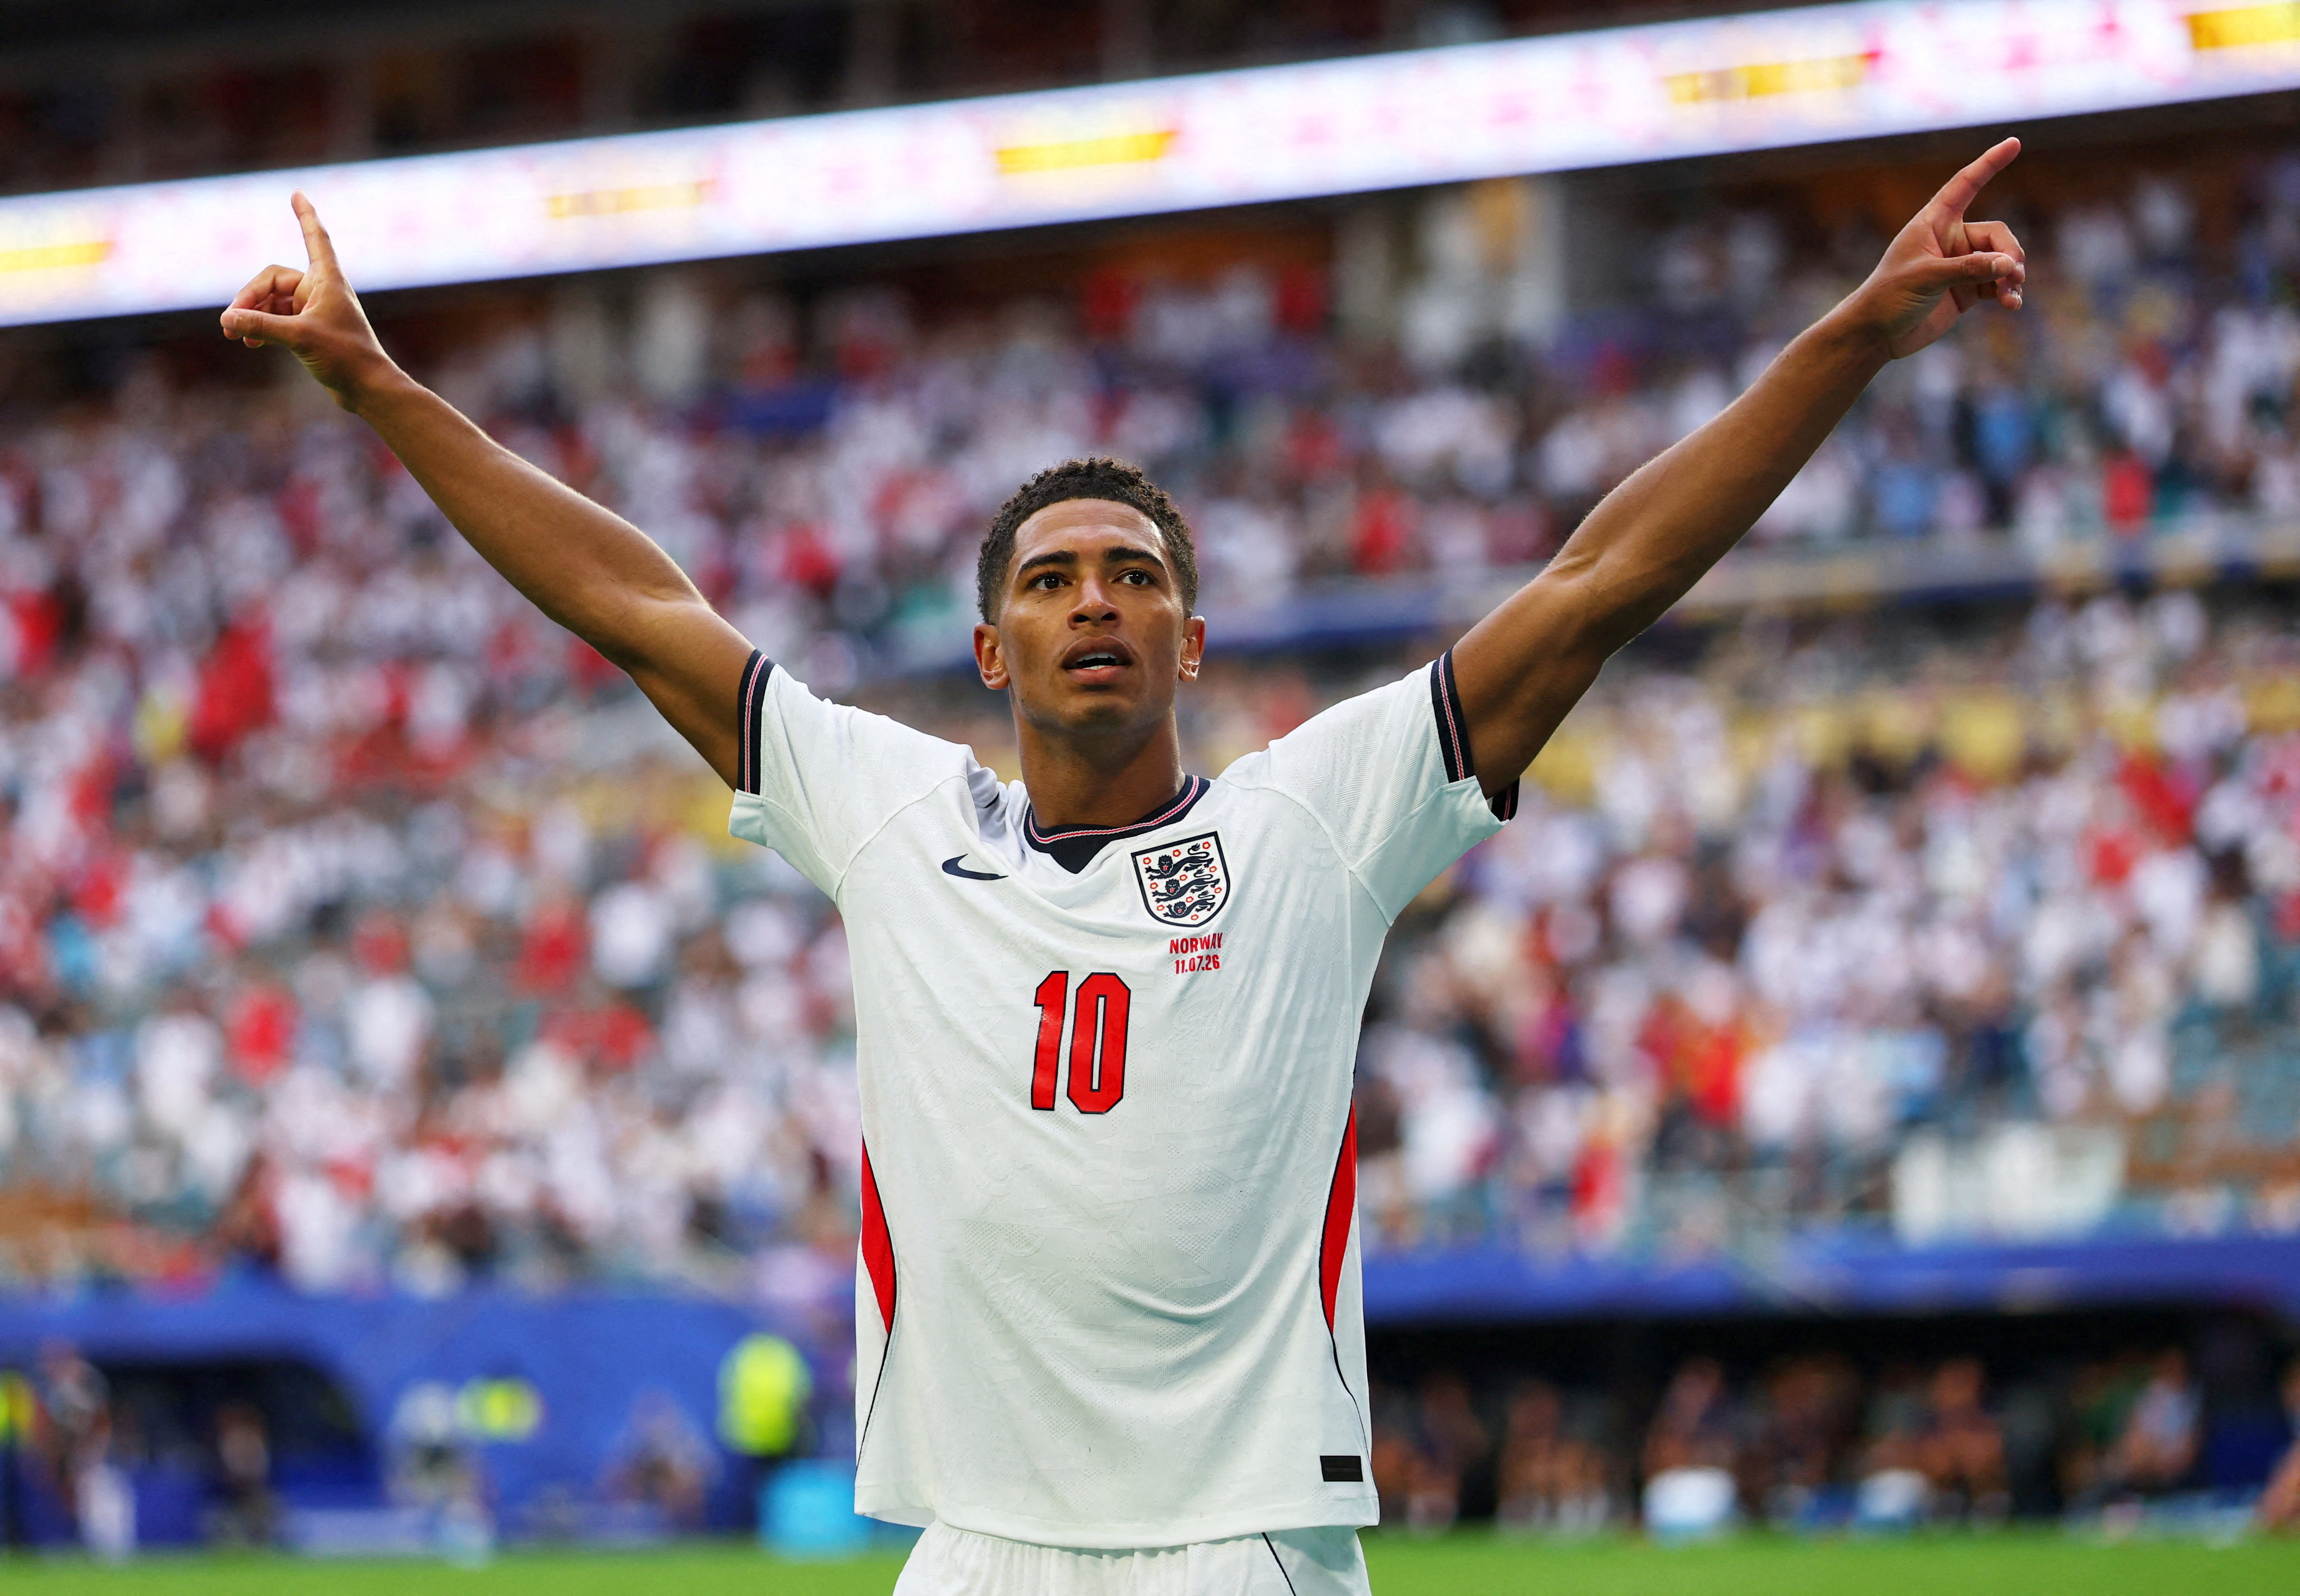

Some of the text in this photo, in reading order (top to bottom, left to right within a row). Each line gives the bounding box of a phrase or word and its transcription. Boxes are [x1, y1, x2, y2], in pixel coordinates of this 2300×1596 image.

[1169, 932, 1223, 954] NORWAY
[1175, 954, 1220, 974] 11.07.26
[1031, 971, 1131, 1114] 10
